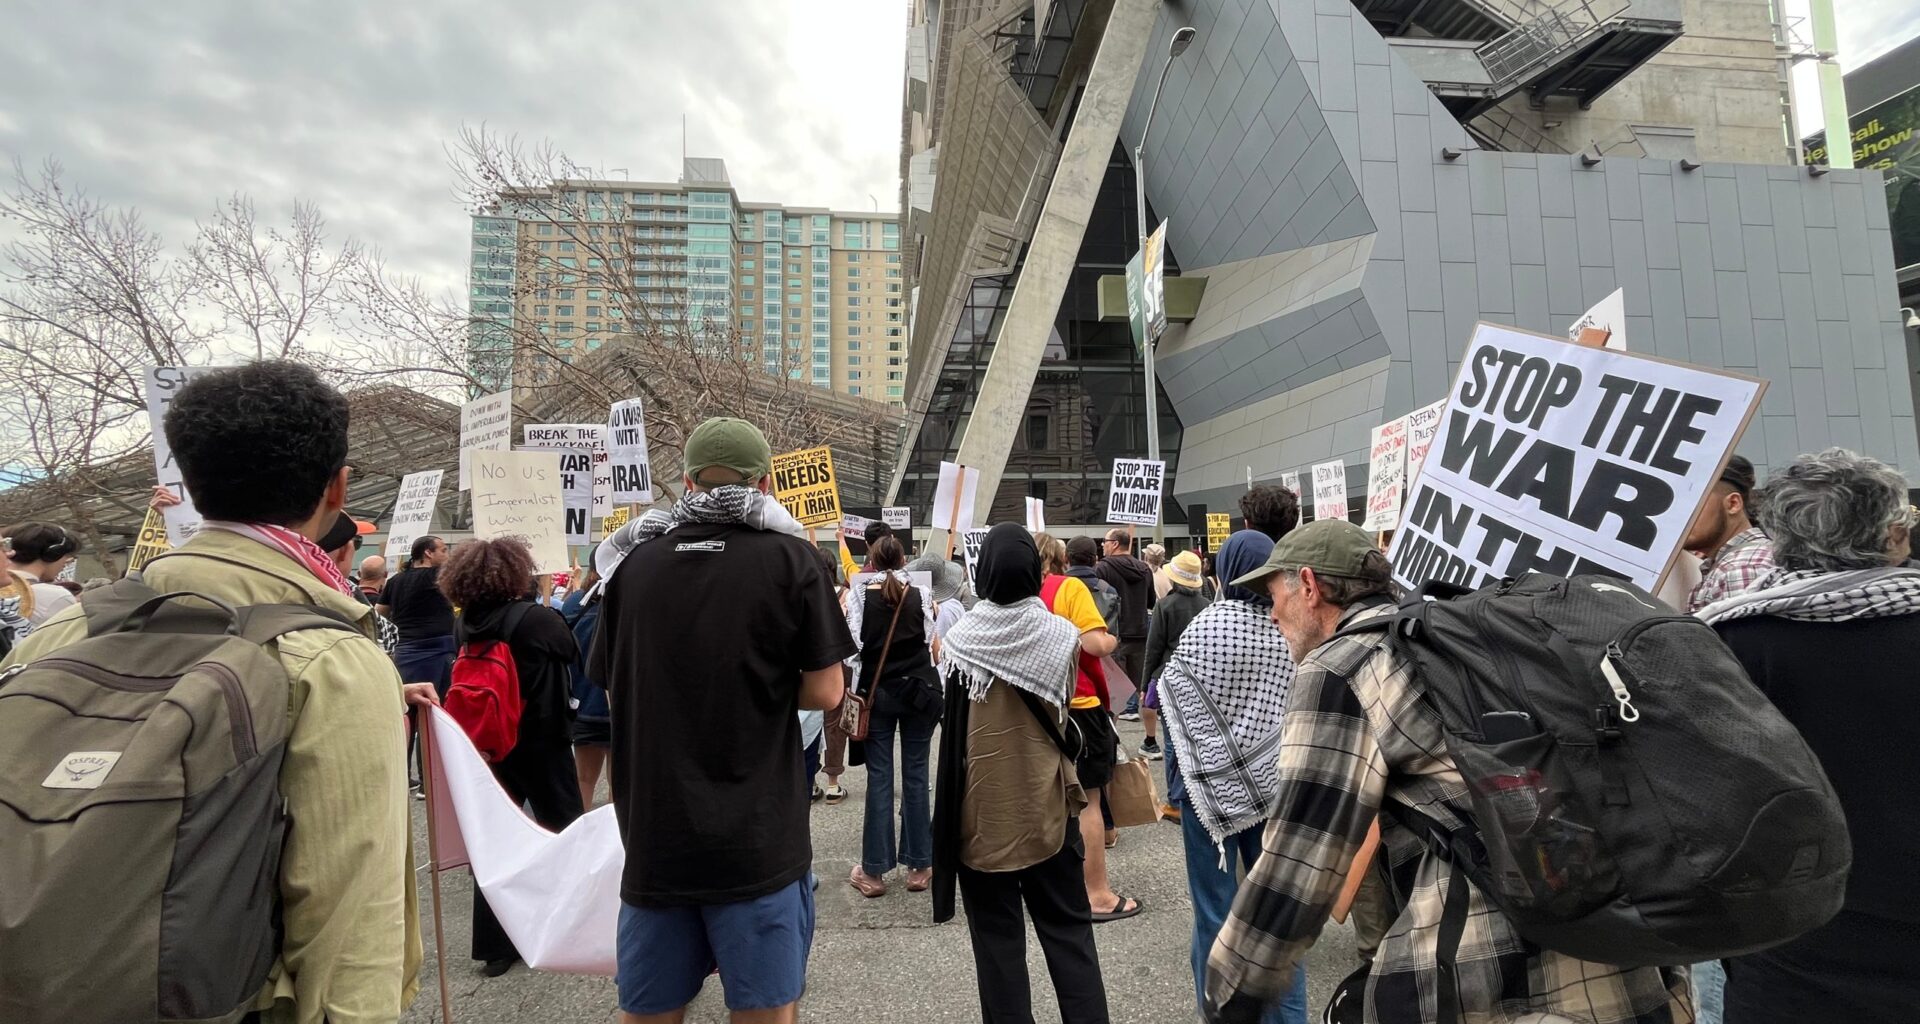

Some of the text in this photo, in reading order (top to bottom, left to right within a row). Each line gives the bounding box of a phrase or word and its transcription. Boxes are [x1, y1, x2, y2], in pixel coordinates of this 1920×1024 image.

[1850, 119, 1885, 144] ali.
[1853, 127, 1912, 162] show
[623, 406, 643, 426] WAR
[1410, 408, 1436, 427] DEFEND
[1459, 344, 1724, 476] STOP THE
[529, 428, 598, 440] BREAK THE
[615, 428, 640, 445] WITH
[1414, 424, 1439, 442] PALEST
[773, 449, 827, 465] MONEY FOR
[774, 455, 828, 471] PEOPLE'S
[482, 463, 506, 479] NO
[611, 463, 650, 492] IRAN
[775, 462, 831, 492] NEEDS
[1115, 462, 1161, 478] STOP THE
[422, 475, 440, 487] OUT
[1115, 476, 1160, 491] WAR
[1439, 408, 1675, 551] WAR
[477, 492, 557, 510] Imperialist
[779, 488, 833, 504] NOT WAR
[804, 495, 836, 515] IRAN
[1111, 492, 1158, 515] ON IRAN!
[488, 514, 528, 525] War
[603, 522, 625, 533] NEED
[1109, 515, 1156, 524] PSLWEB.ORG
[1409, 483, 1634, 580] IN TH
[1391, 527, 1500, 590] MIDD
[68, 757, 109, 766] OSPREY
